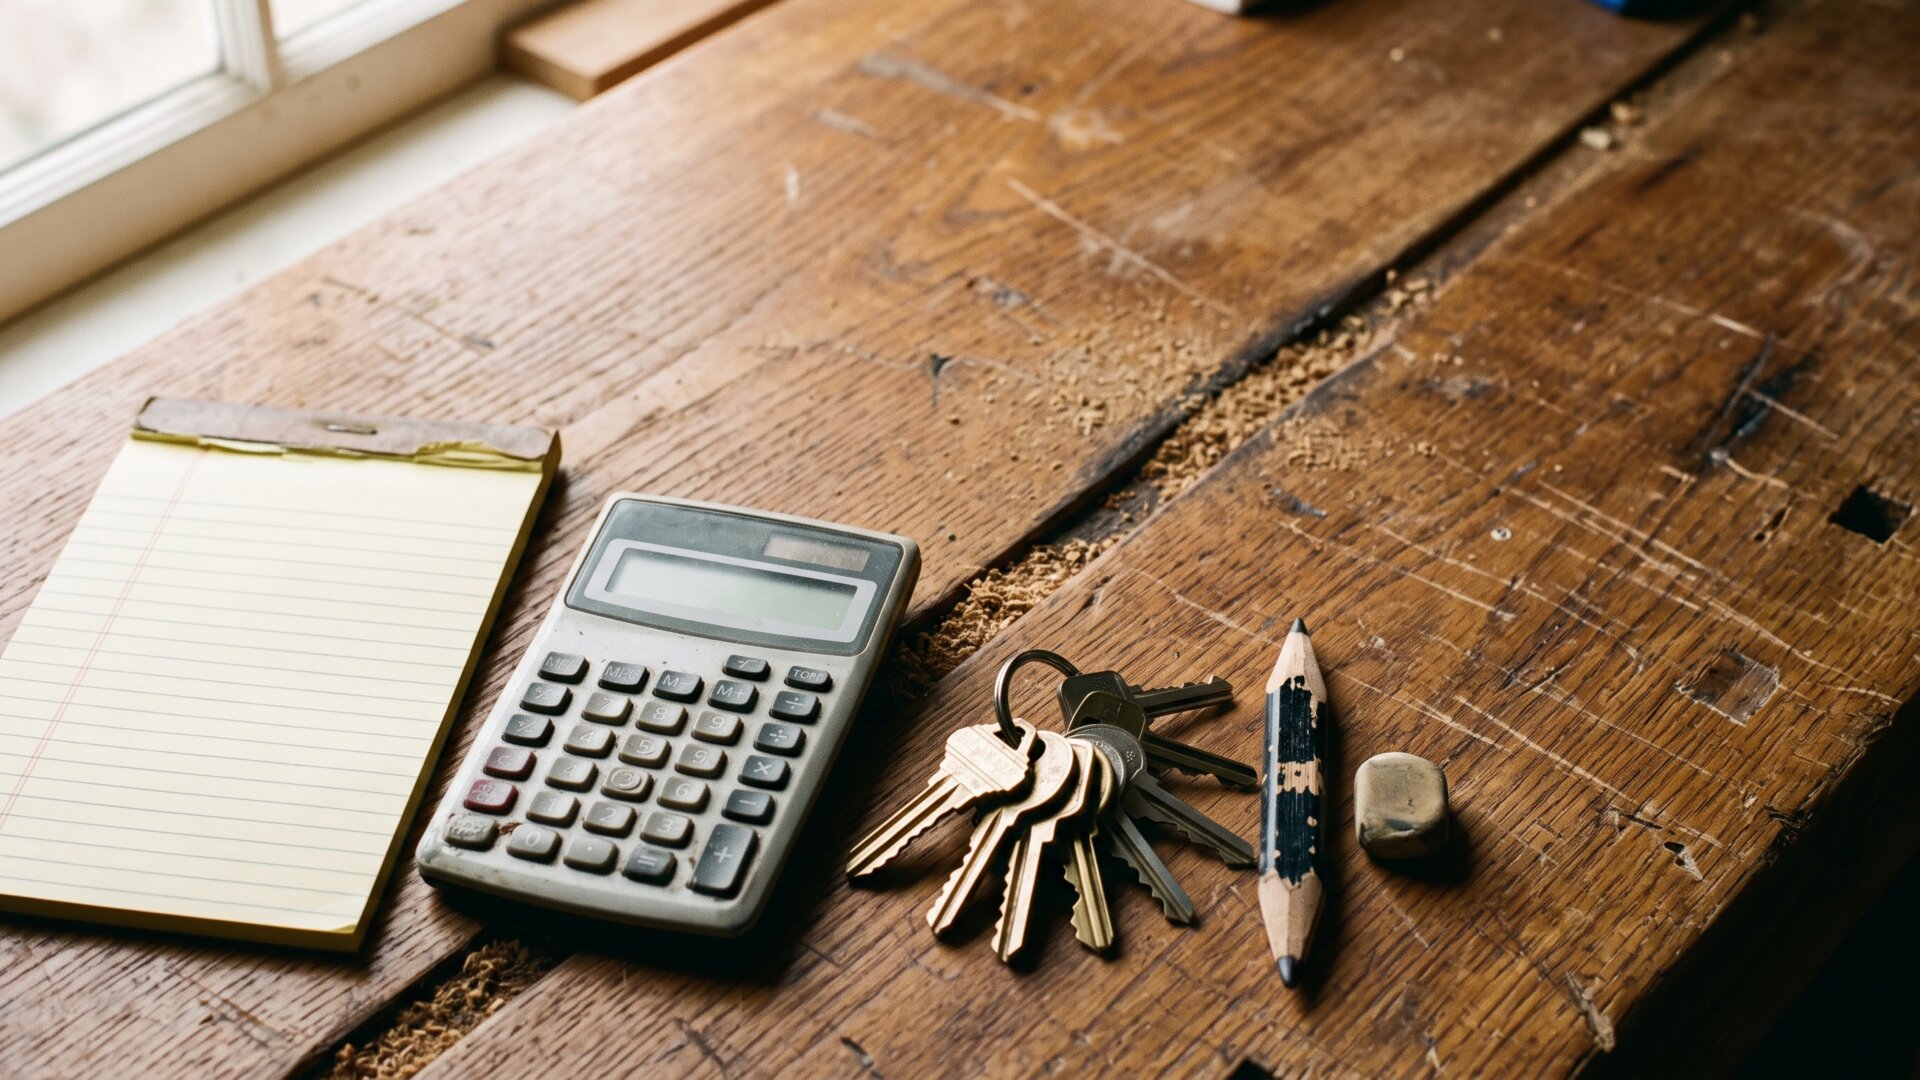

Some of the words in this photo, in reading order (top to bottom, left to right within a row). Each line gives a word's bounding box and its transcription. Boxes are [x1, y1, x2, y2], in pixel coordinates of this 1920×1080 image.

[652, 707, 668, 720] 8
[708, 715, 725, 730] 9
[579, 731, 594, 744] 4
[563, 764, 577, 777] 4
[600, 808, 616, 823] 2
[657, 818, 674, 833] 3
[525, 831, 541, 847] 0
